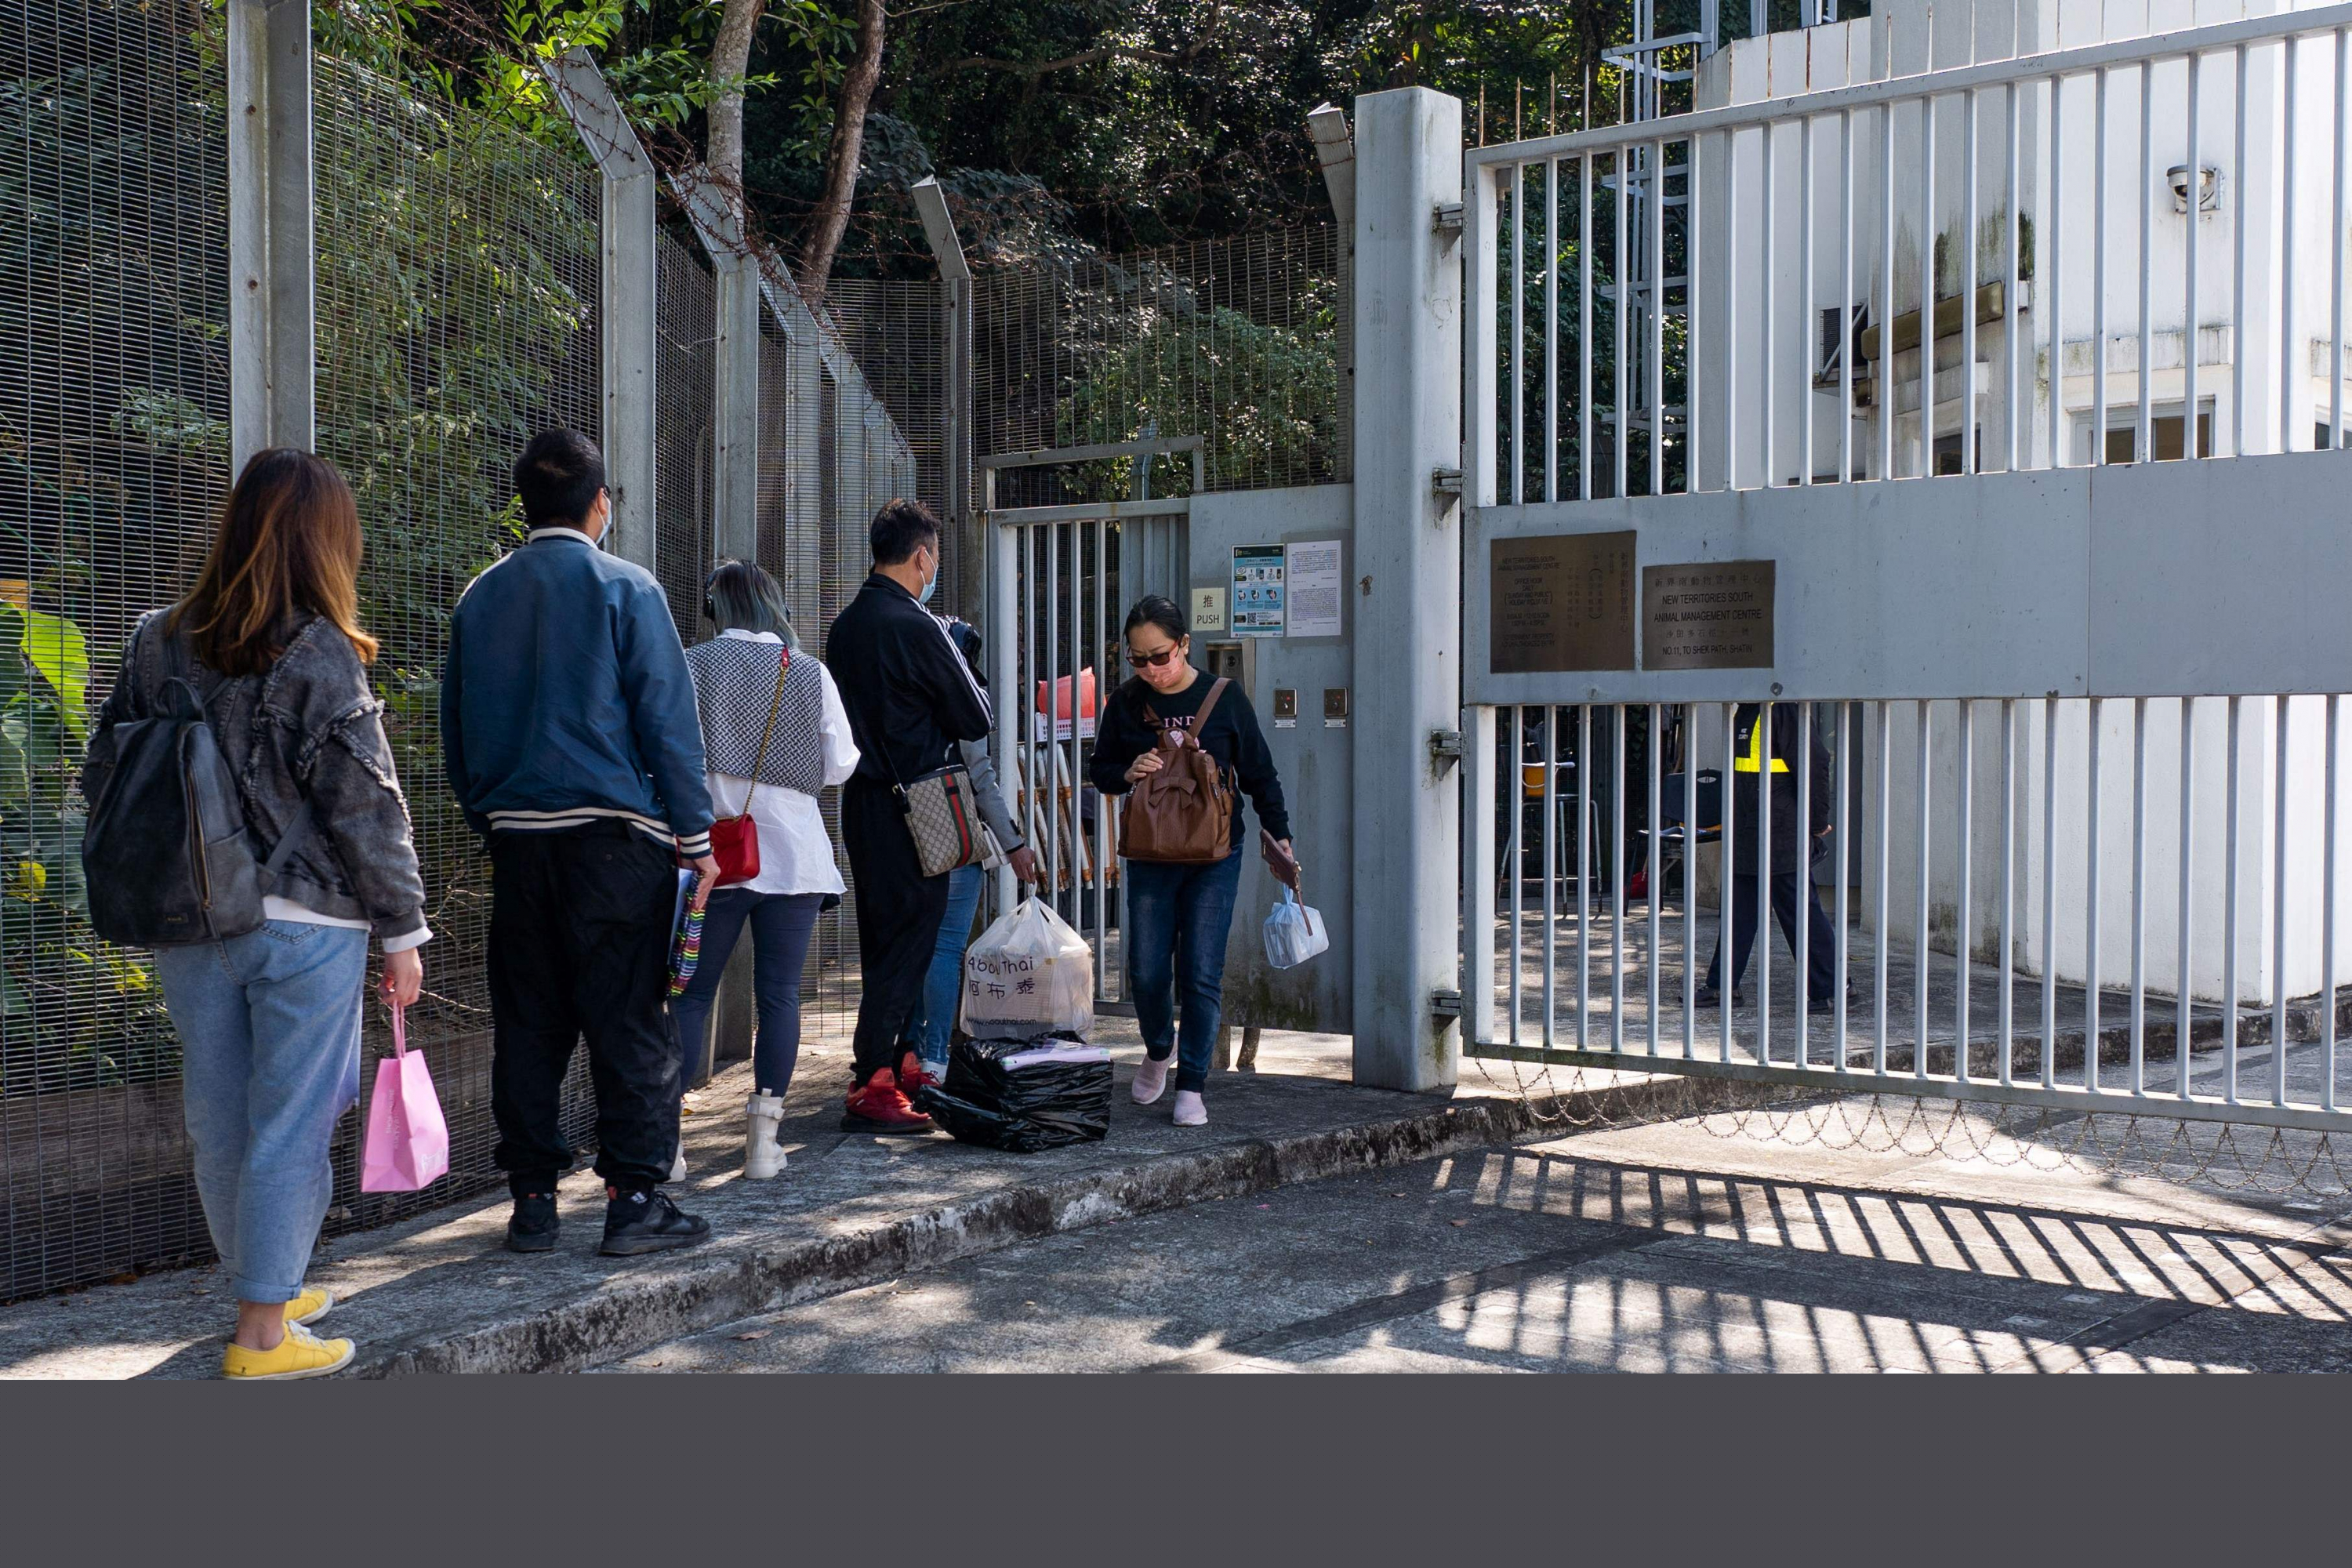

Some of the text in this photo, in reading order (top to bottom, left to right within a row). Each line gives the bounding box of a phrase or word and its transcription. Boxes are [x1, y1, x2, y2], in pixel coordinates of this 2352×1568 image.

[1203, 594, 1214, 608] 推
[1662, 591, 1754, 605] NEW TERRITORIES SOUTH
[1196, 614, 1220, 625] PUSH
[1653, 608, 1762, 623] ANIMAL MANAGEMENT CENTRE
[1682, 645, 1692, 655] TO
[1692, 645, 1710, 655] SHEK
[1729, 644, 1753, 654] SHATIN
